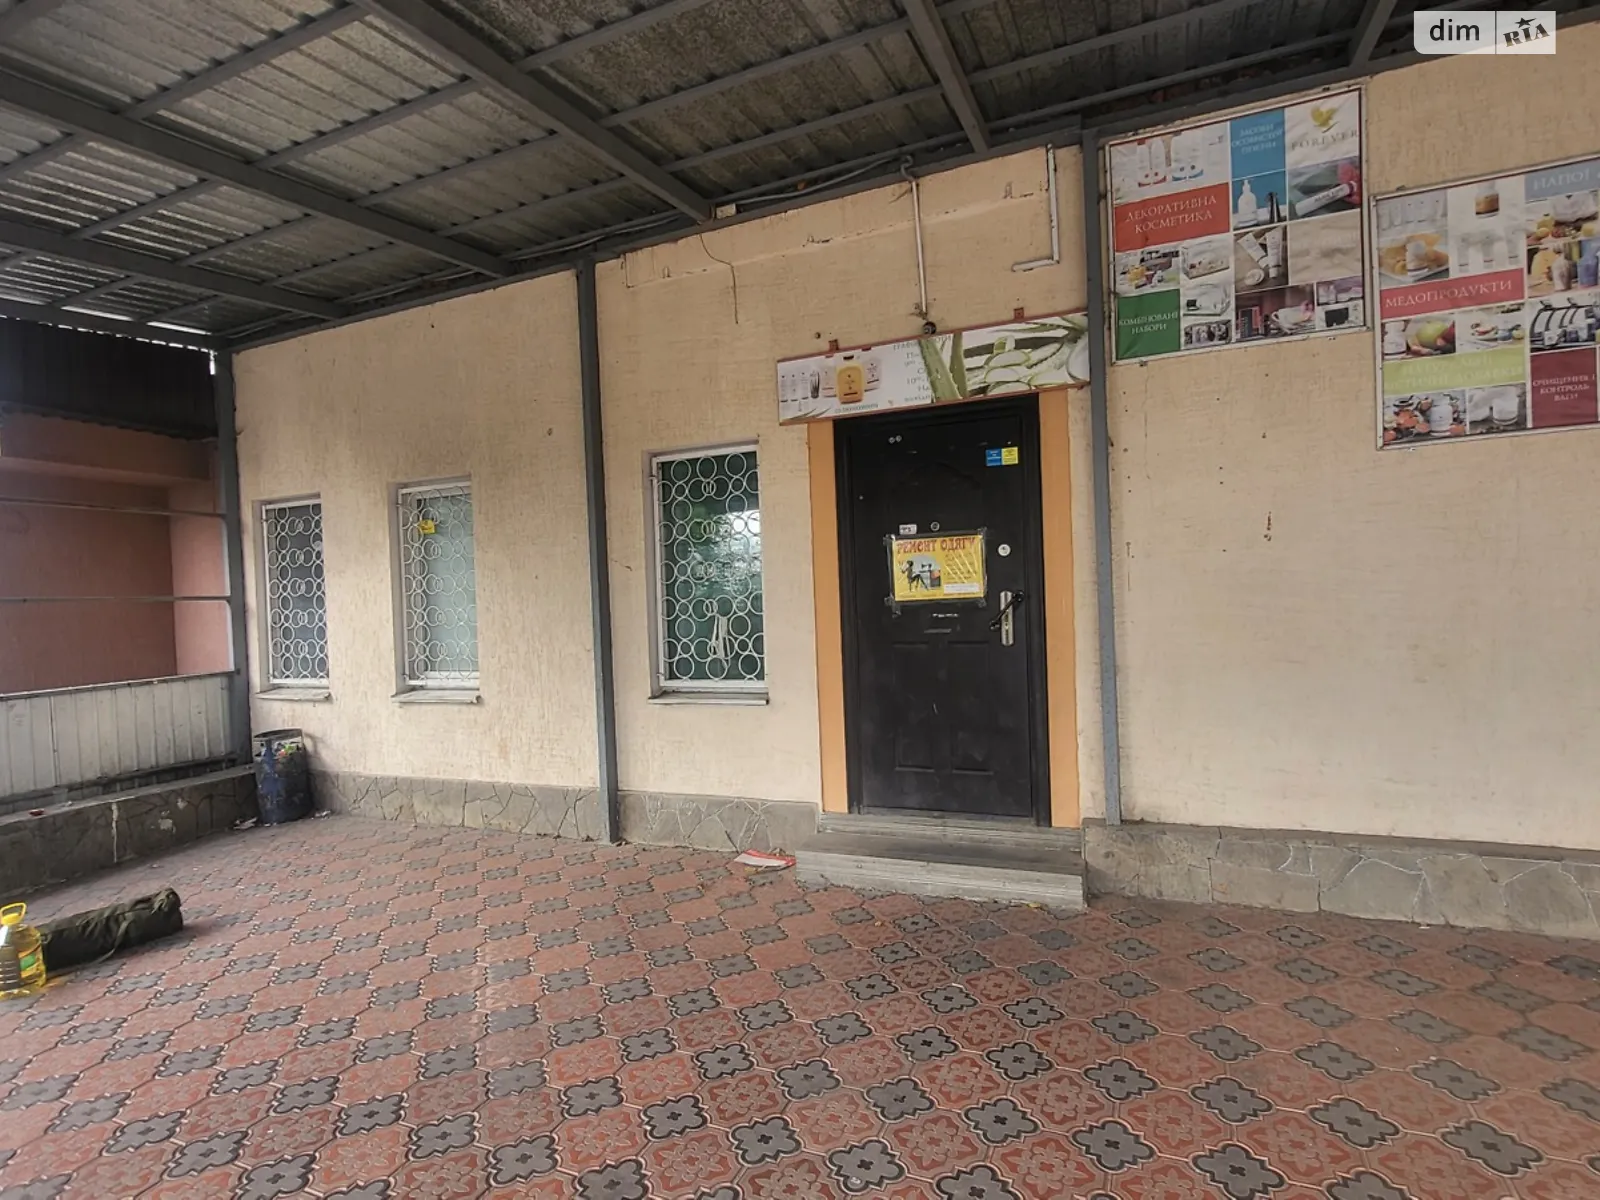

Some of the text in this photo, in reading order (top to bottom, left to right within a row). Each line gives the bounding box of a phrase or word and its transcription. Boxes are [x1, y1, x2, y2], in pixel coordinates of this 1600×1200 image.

[1291, 129, 1358, 151] FOREVER
[1125, 195, 1217, 222] ДЕКОРАТИВНА
[1135, 209, 1213, 234] КОСМЕТИКА
[1385, 280, 1512, 308] МЕДОПРОДУКТИ
[1131, 323, 1167, 335] НАБОРИ
[896, 537, 976, 554] РЕМОНТ ОДЯГУ
